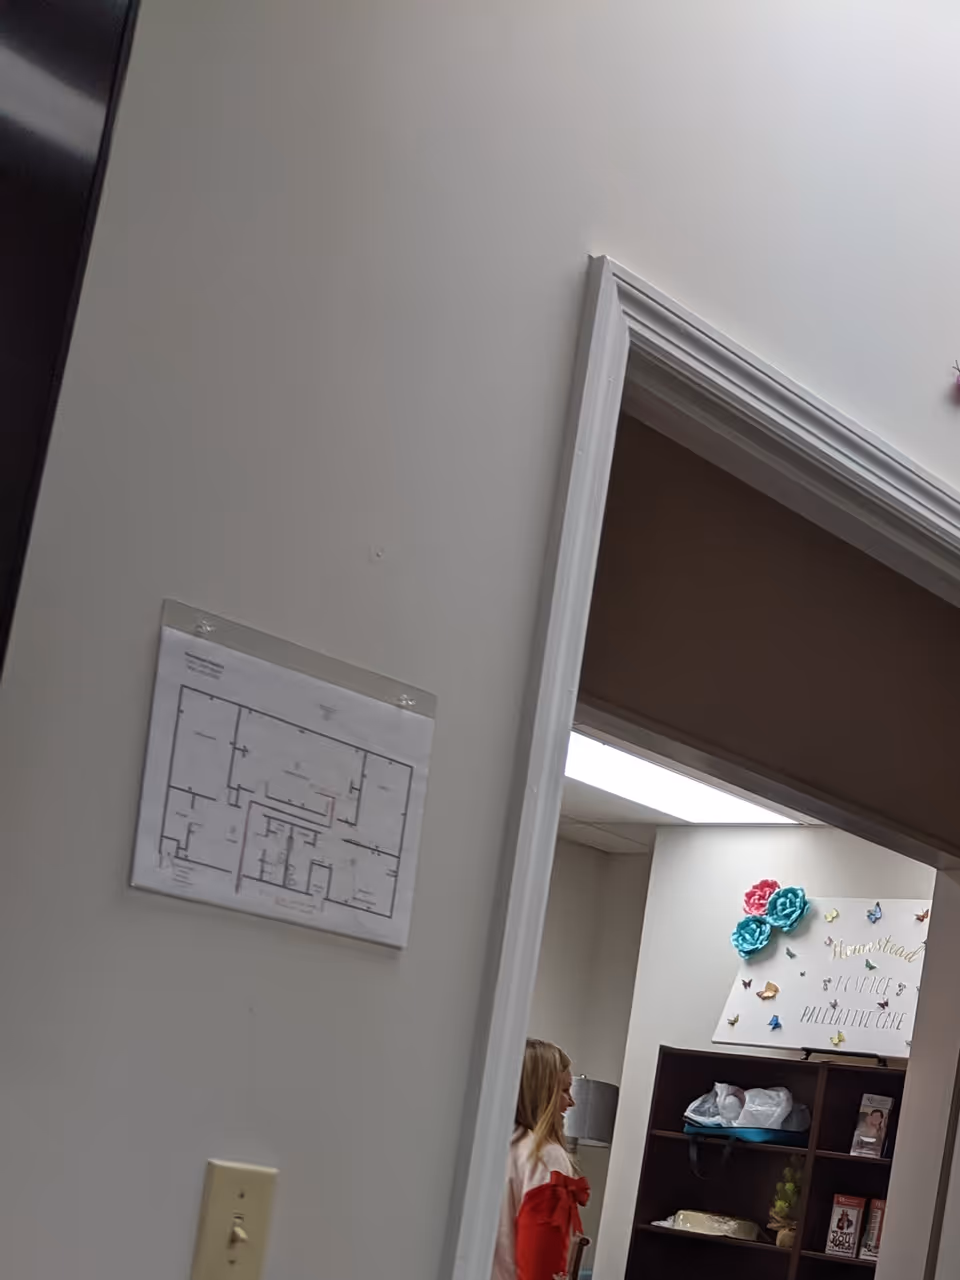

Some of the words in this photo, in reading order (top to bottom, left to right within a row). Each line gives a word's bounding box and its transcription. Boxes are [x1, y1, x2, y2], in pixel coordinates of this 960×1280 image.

[832, 935, 925, 963] Homestead
[800, 1005, 873, 1029] PALLIATIVE
[875, 1010, 908, 1031] CARE
